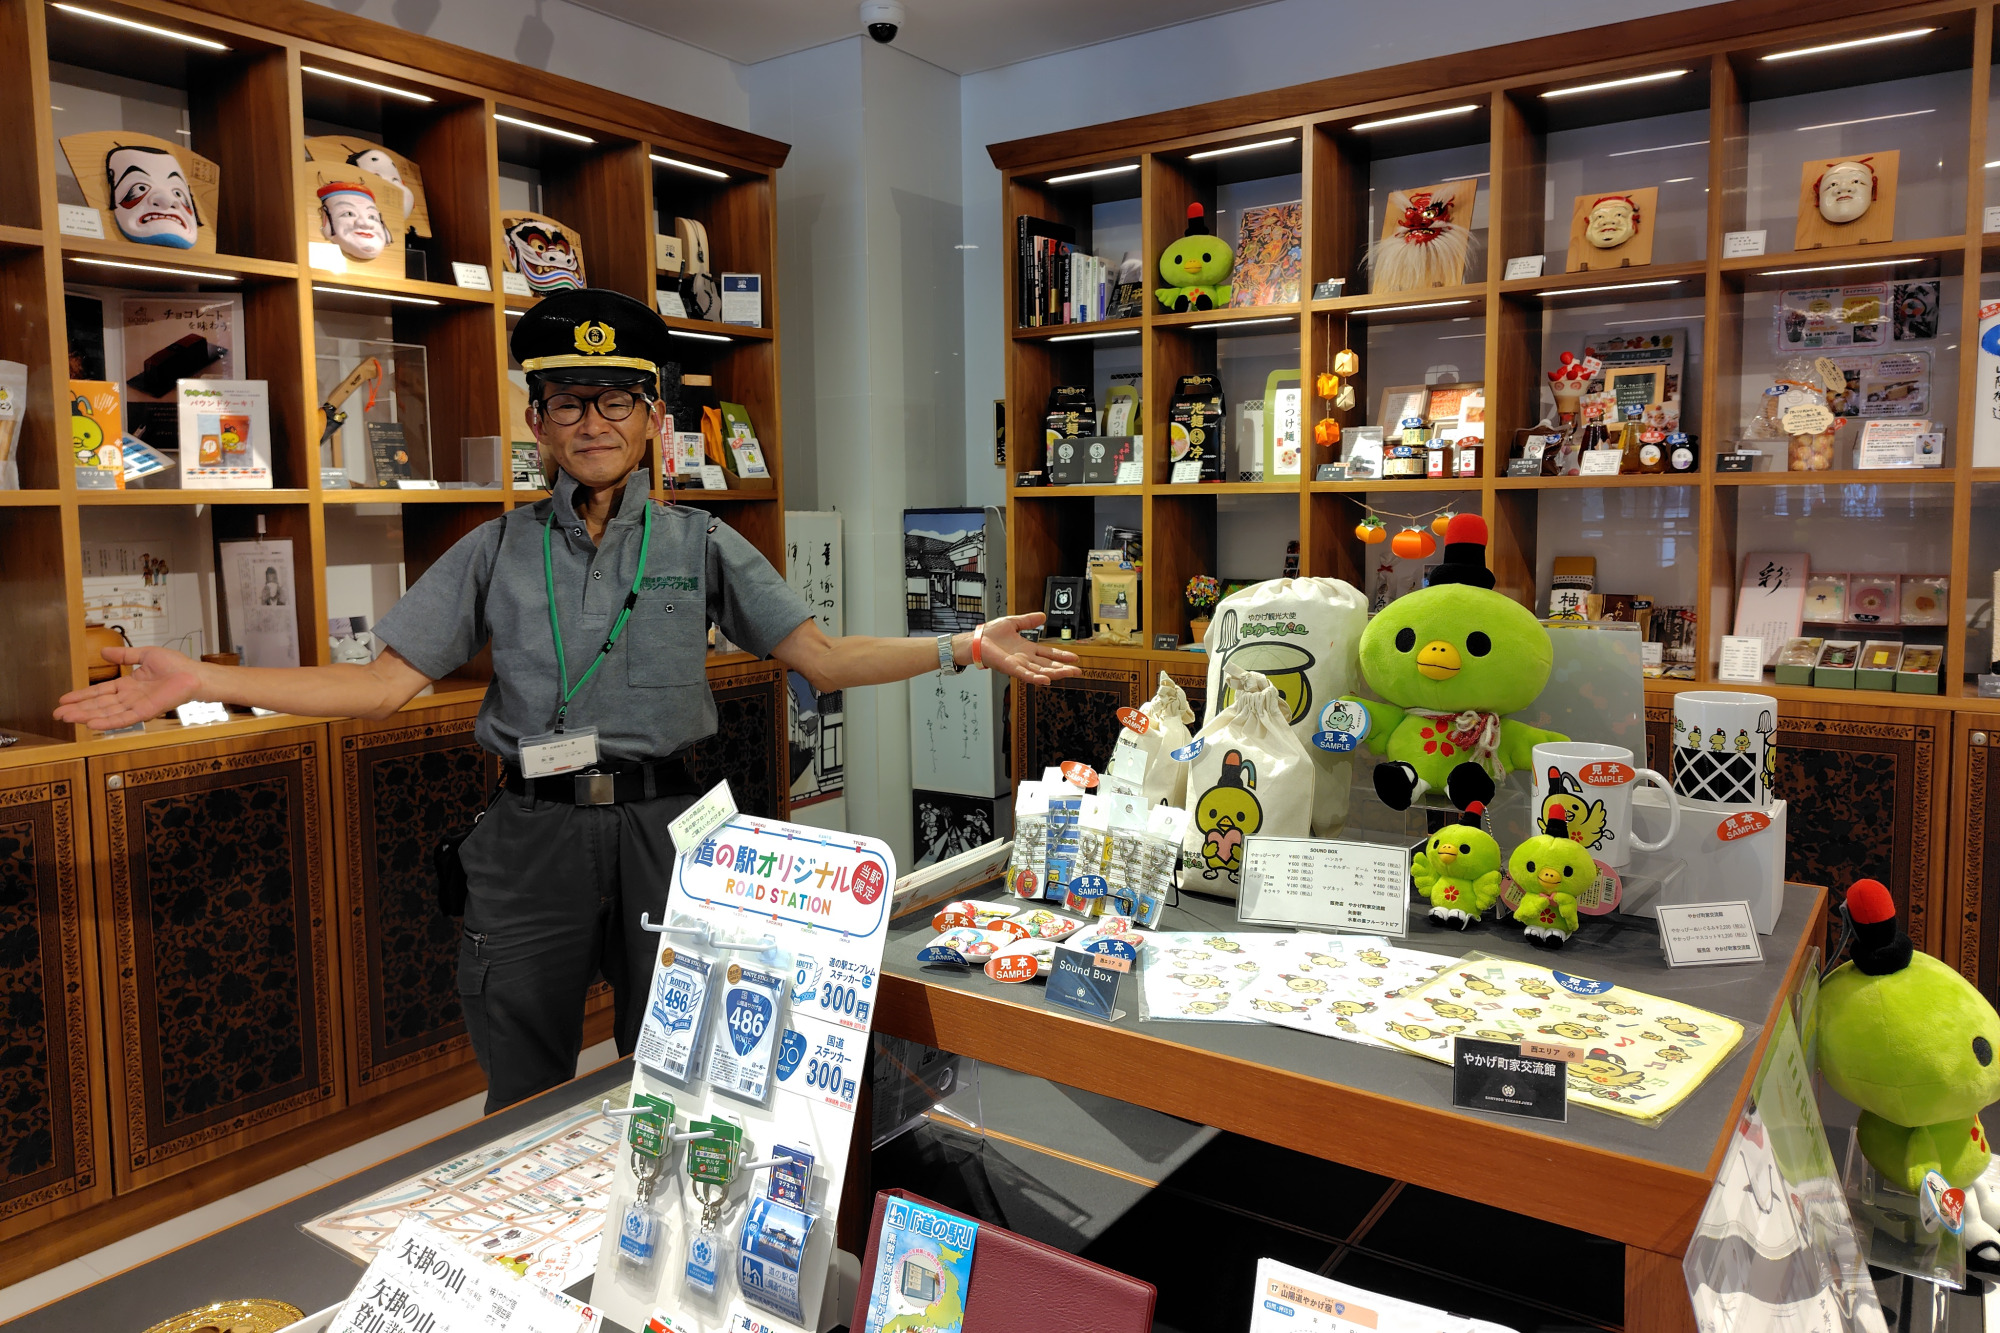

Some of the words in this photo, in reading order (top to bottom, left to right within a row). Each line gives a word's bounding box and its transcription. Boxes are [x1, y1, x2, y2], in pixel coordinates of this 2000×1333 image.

[164, 309, 223, 320] チョコレート
[1285, 408, 1295, 441] つけ麺
[1758, 561, 1784, 597] 彩
[1248, 612, 1297, 621] やかげ観光大使
[1128, 709, 1148, 725] 見本
[1122, 716, 1145, 734] SAMPLE
[1323, 731, 1349, 742] 見本
[1183, 739, 1202, 754] 見本
[1319, 740, 1351, 751] SAMPLE
[1072, 763, 1092, 778] 見本
[1591, 764, 1620, 775] 見本
[1065, 770, 1089, 787] SAMPLE
[1588, 775, 1624, 784] SAMPLE
[677, 805, 706, 829] こちらの商品は
[684, 806, 716, 834] 道の駅フロントで
[691, 807, 726, 839] ご購入いただけます
[1725, 813, 1755, 830] 見本
[1726, 822, 1763, 840] SAMPLE
[694, 838, 851, 893] 道の駅オリジナル
[859, 864, 882, 886] 当駅
[1081, 877, 1101, 886] 見本
[725, 878, 766, 901] ROAD
[769, 887, 832, 916] STATION
[852, 878, 876, 901] 限定
[1078, 888, 1104, 896] SAMPLE
[1348, 902, 1386, 911] やかげ町家交流館
[945, 913, 970, 927] 見本
[1347, 917, 1399, 928] 水車の里フルーツトピア
[1001, 921, 1026, 939] 見本
[1098, 940, 1125, 953] 見本
[1715, 944, 1751, 952] やかげ町家交流館
[829, 957, 876, 977] 道の駅エンブレム
[1000, 956, 1028, 969] 見本
[829, 969, 861, 984] ステッカー
[996, 968, 1032, 979] SAMPLE
[1059, 959, 1090, 977] Sound
[1092, 968, 1113, 983] Box
[669, 976, 692, 991] ROUTE
[1560, 980, 1602, 995] SAMPLE
[1568, 976, 1601, 989] 見本
[664, 988, 689, 1013] 486
[741, 990, 760, 1003] 国道
[820, 982, 869, 1021] 300円
[729, 1006, 764, 1038] 486
[735, 1033, 752, 1045] ROUTE
[826, 1035, 845, 1049] 国道
[814, 1045, 852, 1063] ステッカー
[1530, 1045, 1560, 1056] 西エリア
[1463, 1052, 1556, 1077] やかげ町家交流館
[806, 1057, 856, 1099] 300円
[635, 1129, 657, 1140] キーホルダー
[643, 1139, 654, 1147] 当駅
[696, 1158, 725, 1166] キーホルダー
[707, 1165, 720, 1174] 当駅
[778, 1181, 798, 1191] マグネット
[785, 1190, 796, 1200] 当駅
[909, 1208, 974, 1250] 「道の駅」
[397, 1237, 467, 1295] 矢掛の山
[767, 1266, 789, 1281] 道の駅
[1271, 1284, 1279, 1292] 17
[367, 1278, 436, 1333] 矢掛の山
[1281, 1288, 1333, 1314] 山陽道やかげ宿
